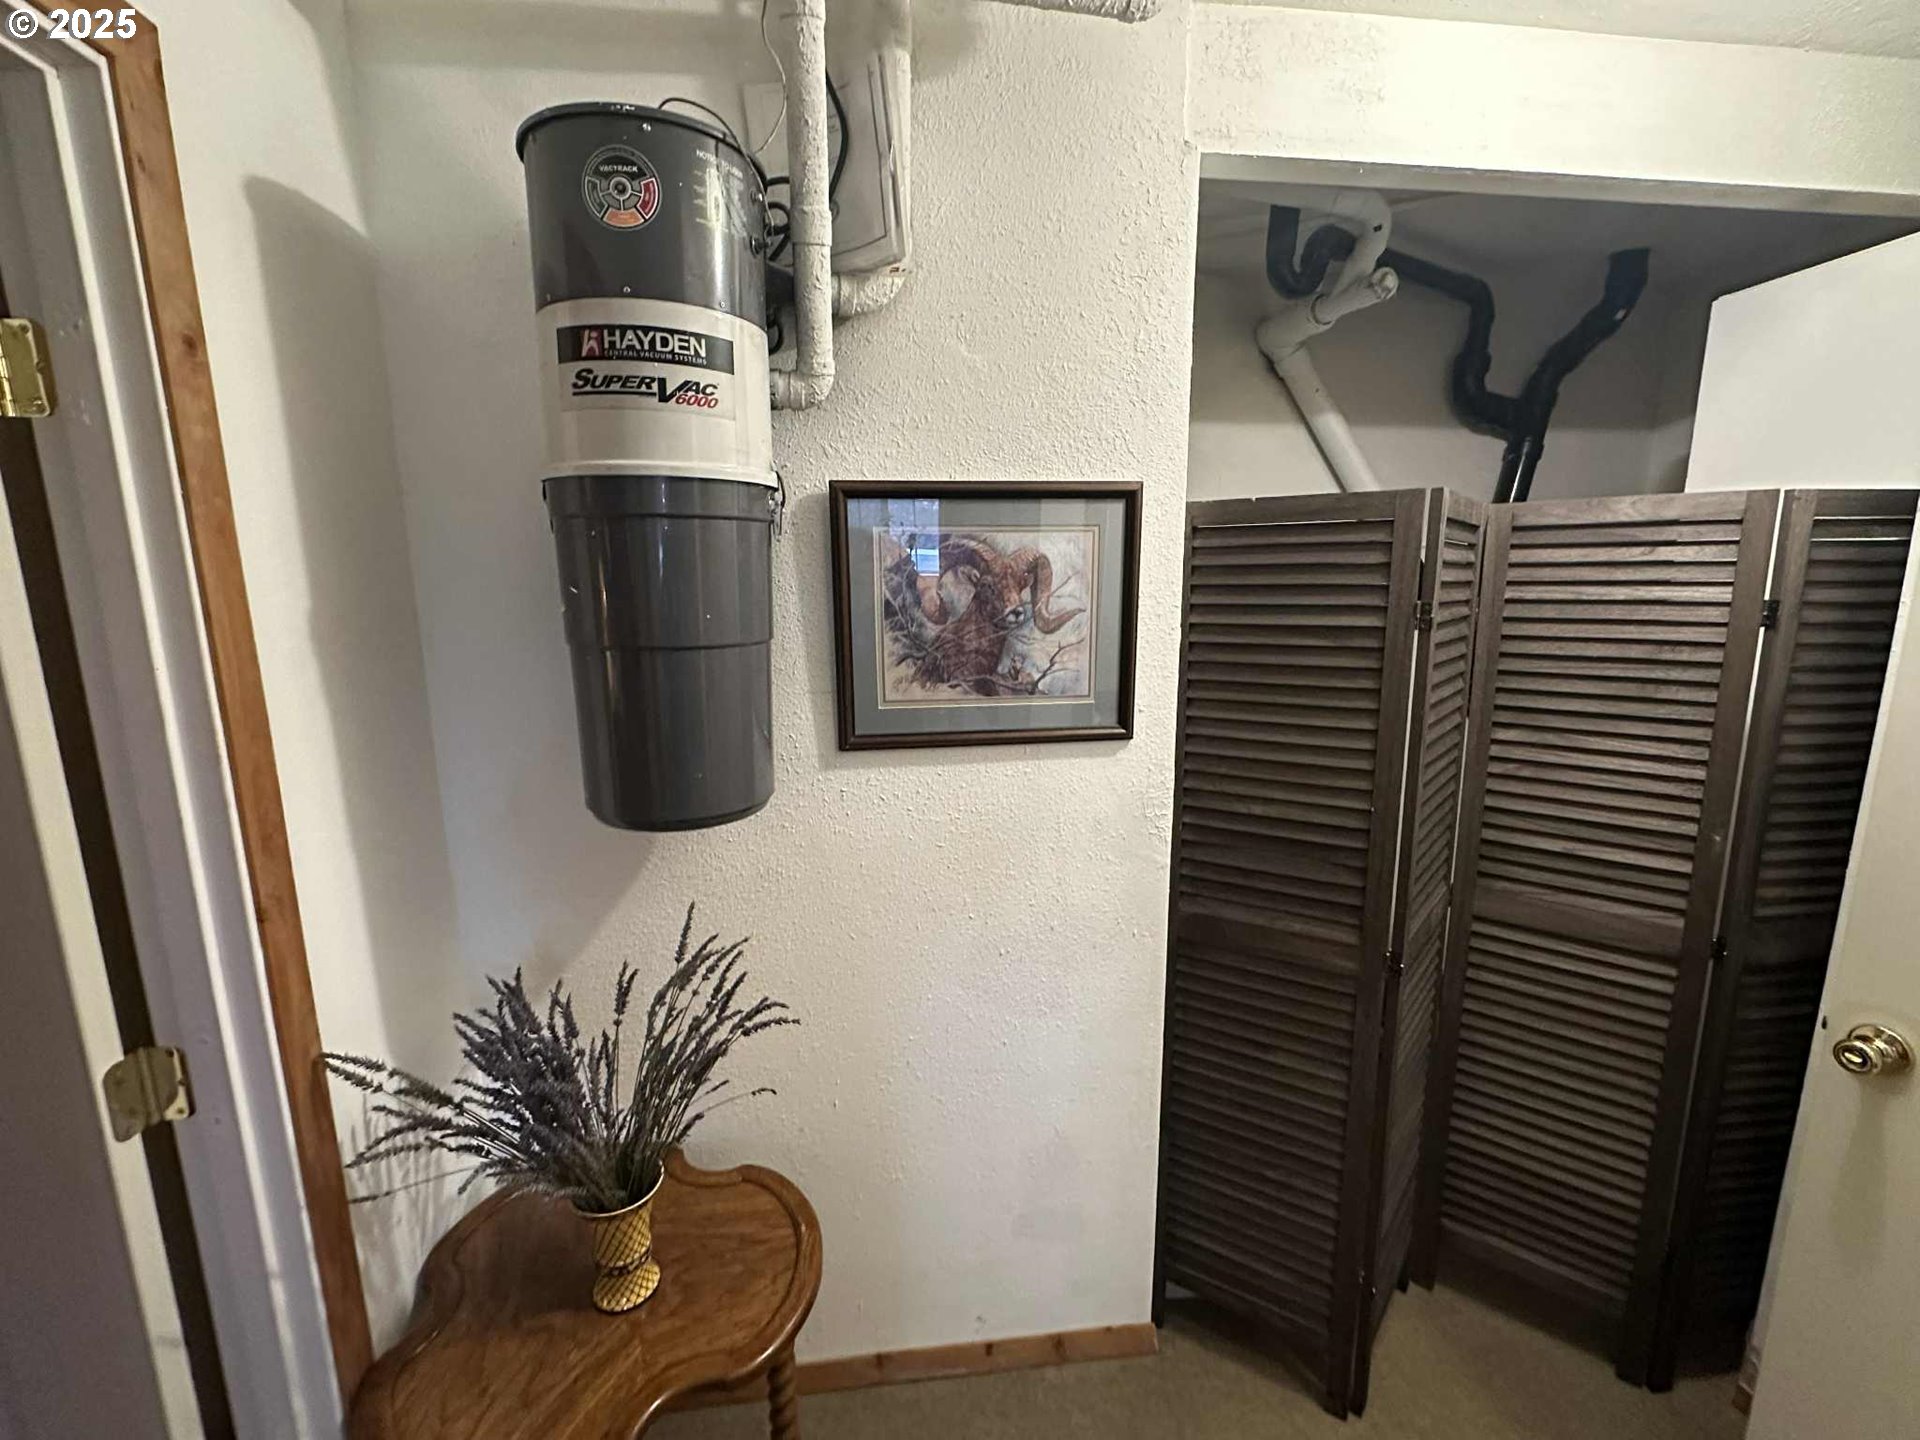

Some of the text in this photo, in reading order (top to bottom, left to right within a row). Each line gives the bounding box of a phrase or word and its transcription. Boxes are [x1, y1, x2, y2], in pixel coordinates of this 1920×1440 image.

[603, 329, 706, 357] HAYDEN
[604, 350, 707, 365] CENTRAL VACUUM SYSTEMS
[675, 394, 718, 409] 6000
